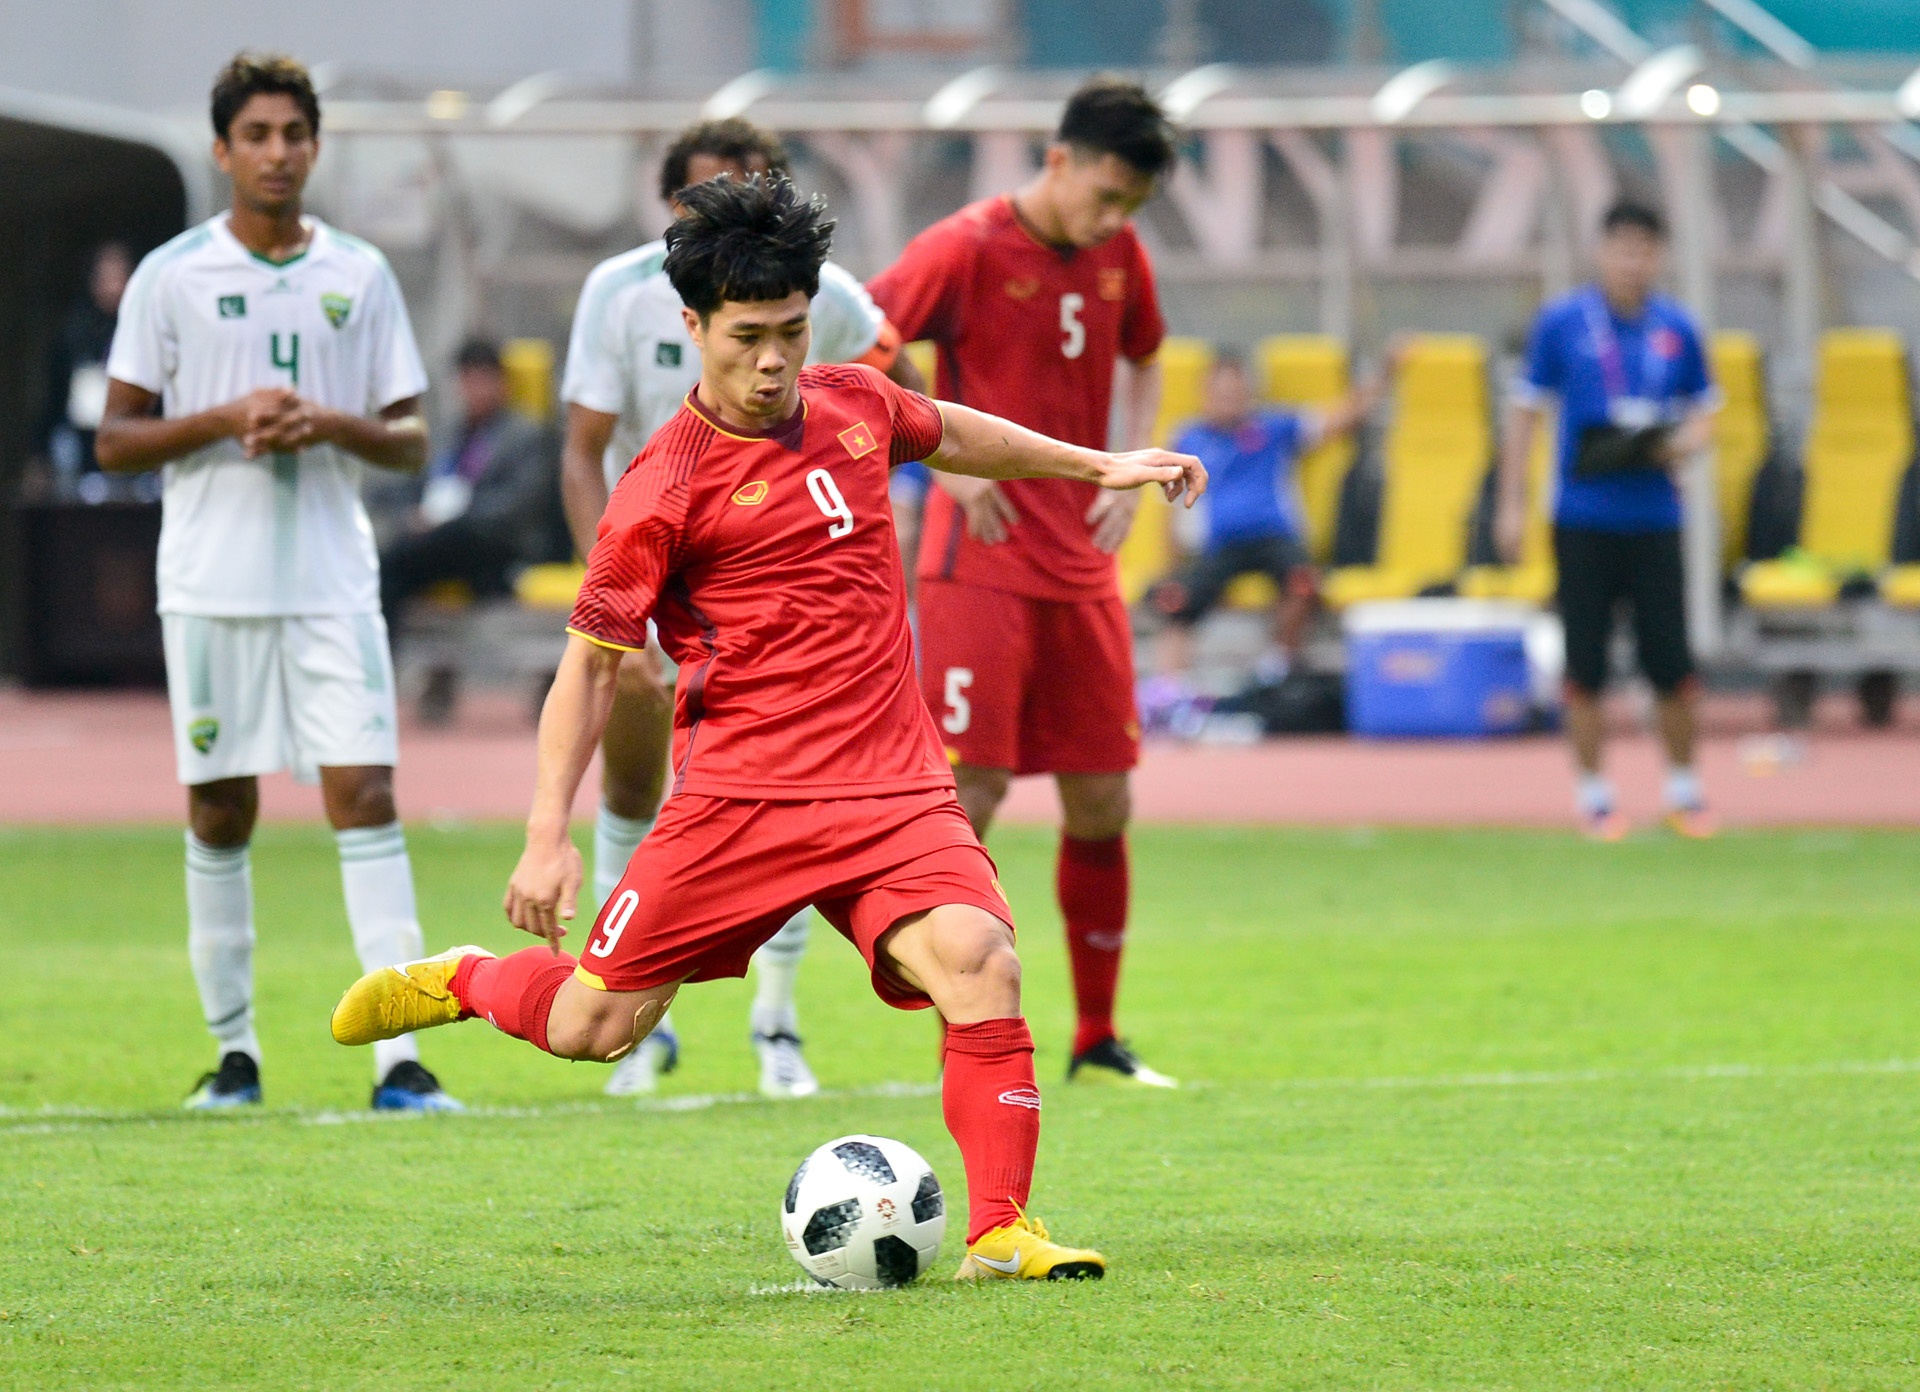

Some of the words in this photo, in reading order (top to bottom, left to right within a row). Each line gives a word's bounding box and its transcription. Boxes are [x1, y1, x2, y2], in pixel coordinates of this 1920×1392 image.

[270, 333, 299, 387] 4
[1060, 292, 1086, 359] 5
[805, 468, 854, 539] 9
[942, 666, 974, 735] 5
[589, 889, 640, 958] 9
